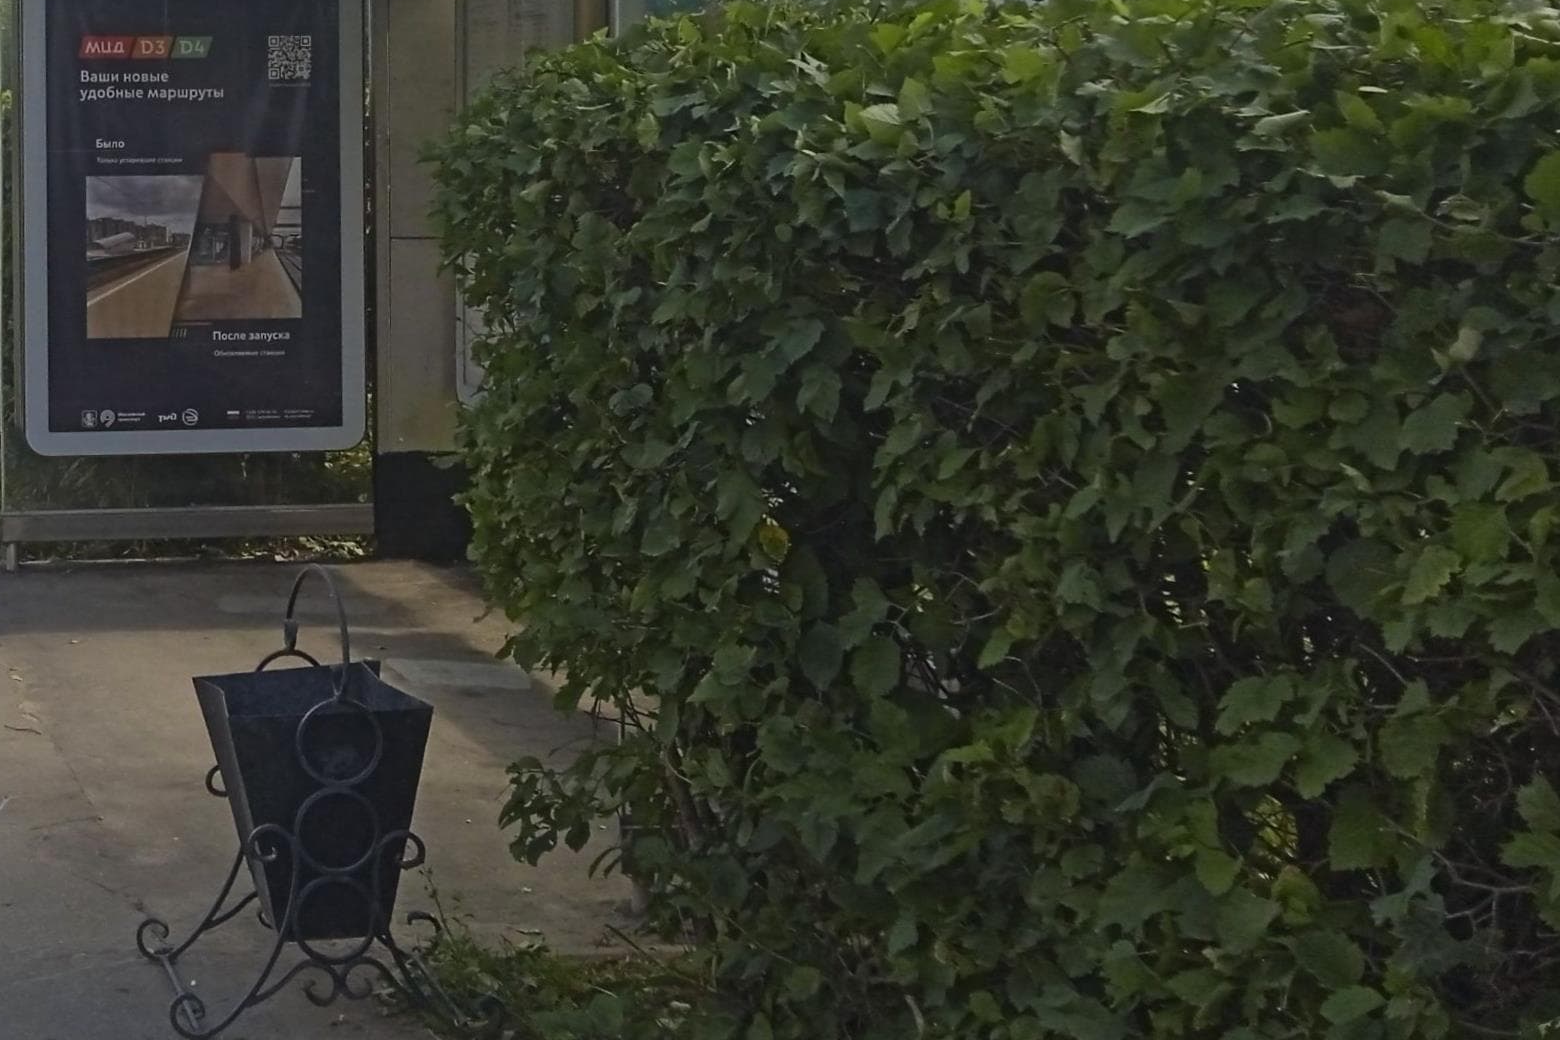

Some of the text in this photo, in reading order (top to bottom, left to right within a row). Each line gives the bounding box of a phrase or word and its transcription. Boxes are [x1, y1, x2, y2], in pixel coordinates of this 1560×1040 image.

[141, 40, 165, 54] D3
[179, 40, 204, 54] D4
[80, 70, 169, 83] Ваши новые
[80, 86, 224, 102] удобные маршруты
[95, 138, 125, 149] Было
[213, 330, 290, 342] После запуска
